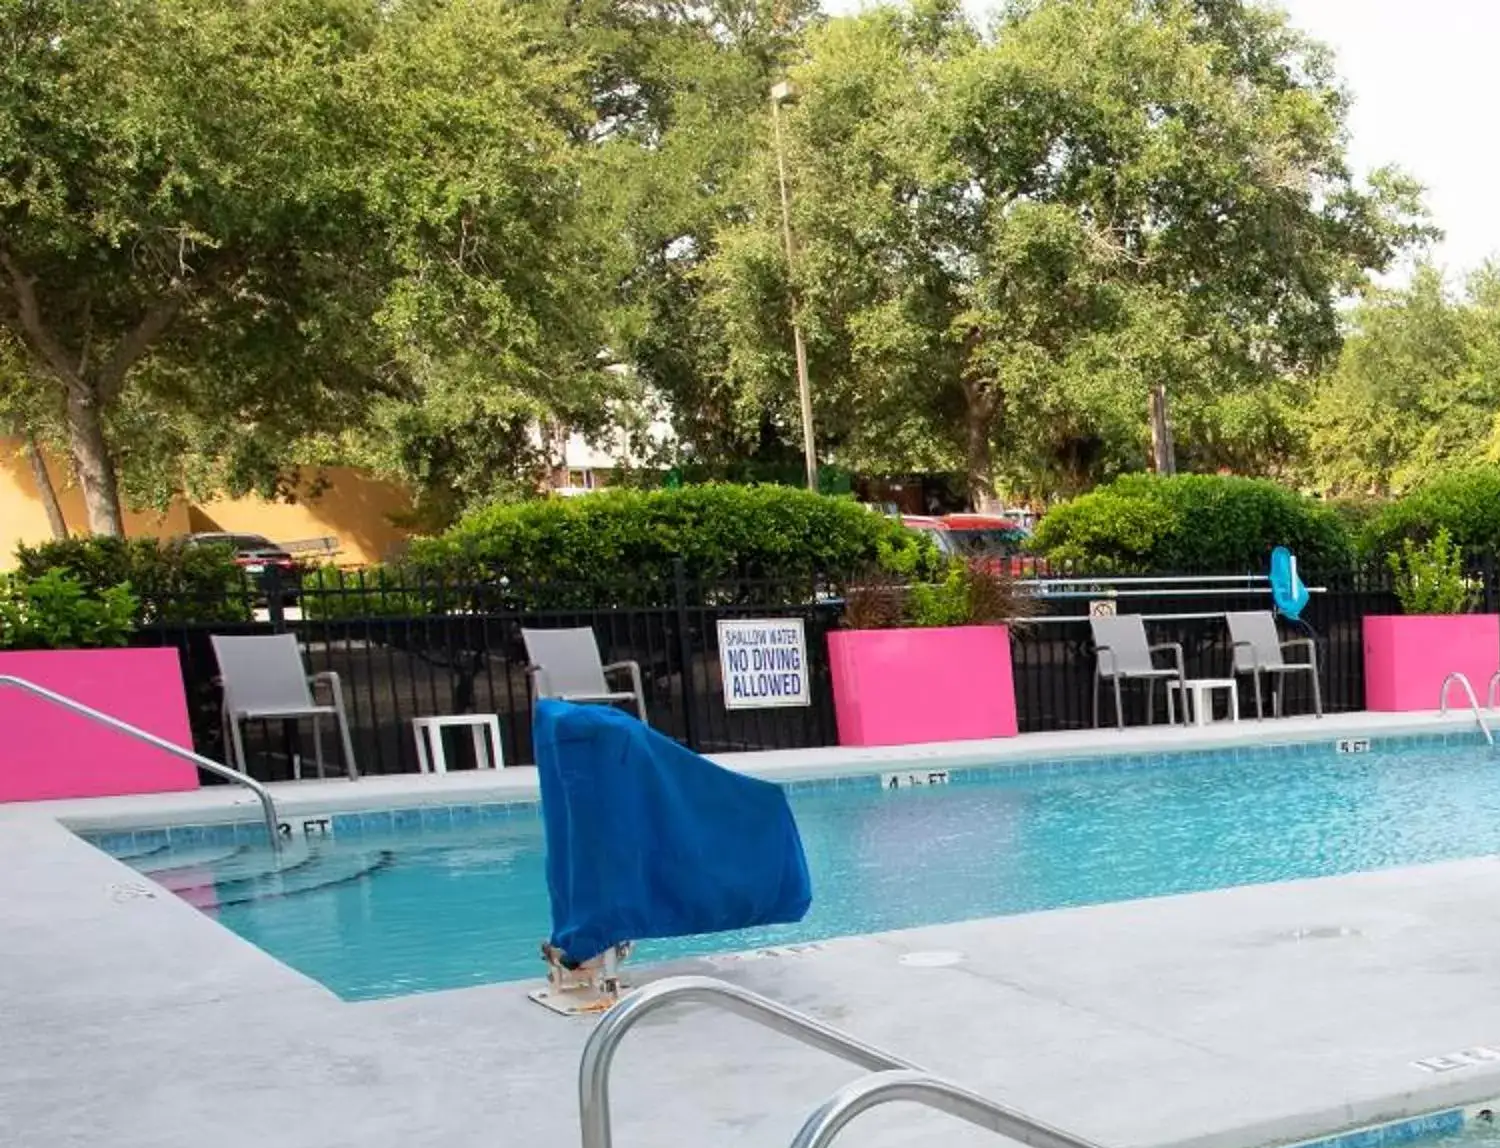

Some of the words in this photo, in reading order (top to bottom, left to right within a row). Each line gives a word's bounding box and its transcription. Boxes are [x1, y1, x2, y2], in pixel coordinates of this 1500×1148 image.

[725, 629, 767, 646] SHALLOW
[727, 648, 748, 672] NO
[752, 647, 801, 671] DIVING
[733, 673, 801, 698] ALLOWED
[303, 819, 329, 838] FT
